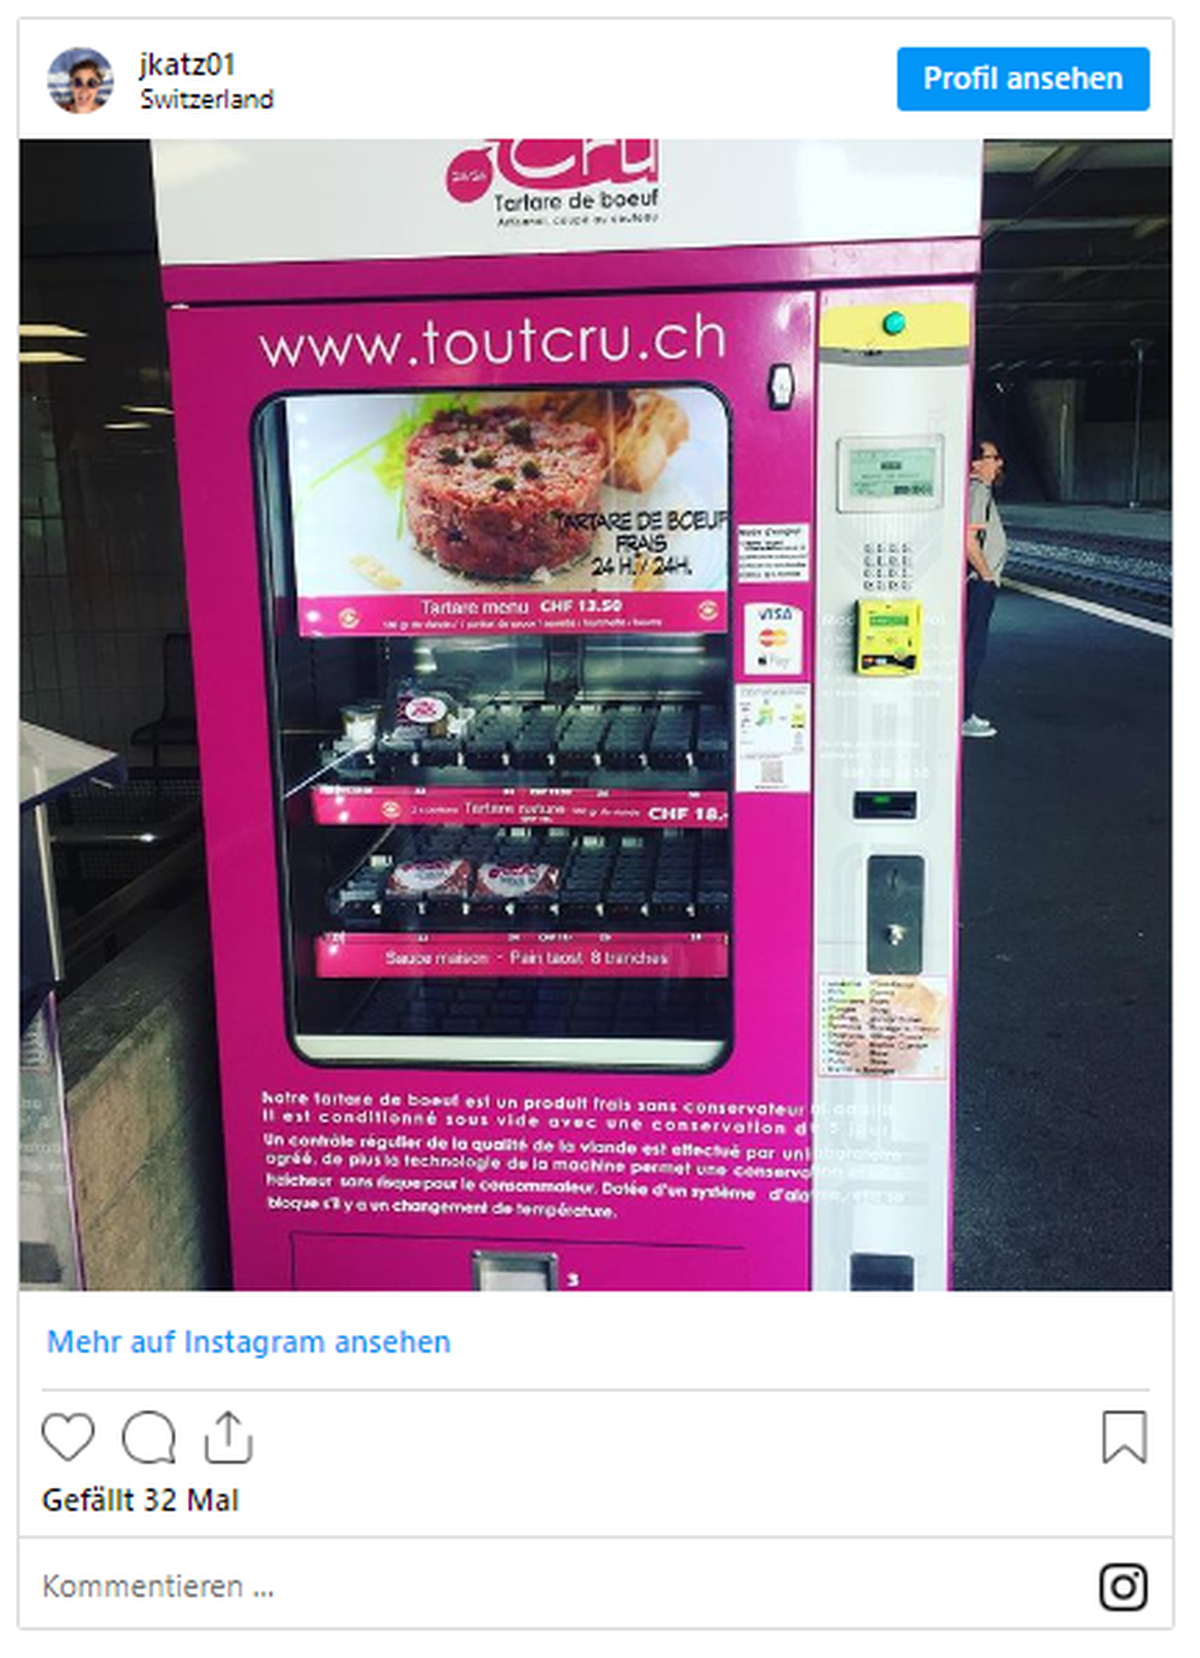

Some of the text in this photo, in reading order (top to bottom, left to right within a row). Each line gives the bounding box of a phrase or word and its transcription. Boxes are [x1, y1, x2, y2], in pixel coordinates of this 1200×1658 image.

[494, 188, 659, 212] Tartare de boeuf
[259, 312, 726, 368] www.toutcru.ch
[557, 511, 632, 531] TARTARE
[637, 511, 662, 530] DE
[616, 535, 667, 552] FRAIS
[592, 557, 615, 575] 24
[421, 599, 479, 615] Tartare
[483, 601, 529, 614] menu
[540, 599, 573, 612] CHF
[758, 608, 793, 620] VISA
[648, 807, 689, 820] CHF
[314, 1092, 373, 1106] tartare
[379, 1093, 402, 1106] de
[465, 1095, 490, 1109] est
[496, 1098, 518, 1109] un
[524, 1096, 589, 1112] produit
[593, 1097, 632, 1112] frais
[637, 1100, 678, 1113] sans
[683, 1101, 805, 1117] conservateur
[282, 1109, 311, 1123] est
[319, 1110, 438, 1126] conditionné
[446, 1114, 489, 1127] sous
[496, 1114, 540, 1129] vide
[549, 1117, 598, 1130] avec
[606, 1118, 643, 1131] une
[651, 1119, 786, 1135] conservation
[263, 1133, 284, 1147] Un
[289, 1133, 355, 1148] contrôle
[360, 1134, 422, 1151] régulier
[426, 1136, 449, 1149] de
[452, 1137, 468, 1150] la
[471, 1138, 528, 1154] qualité
[533, 1140, 554, 1152] de
[559, 1140, 575, 1153] la
[579, 1141, 637, 1155] viande
[641, 1143, 667, 1156] est
[672, 1143, 740, 1159] effectué
[746, 1147, 775, 1162] par
[321, 1151, 343, 1165] de
[349, 1153, 381, 1169] plus
[384, 1154, 399, 1168] la
[404, 1154, 501, 1173] technologie
[507, 1157, 528, 1170] de
[532, 1158, 548, 1171] la
[552, 1157, 626, 1173] machine
[630, 1161, 691, 1176] permet
[696, 1165, 727, 1177] une
[340, 1176, 373, 1188] sans
[423, 1178, 458, 1192] pour
[461, 1178, 475, 1191] le
[602, 1181, 649, 1196] Dotée
[652, 1183, 687, 1197] d'un
[691, 1185, 756, 1200] système
[268, 1196, 319, 1212] bloque
[344, 1200, 353, 1212] y
[356, 1201, 367, 1211] a
[370, 1201, 389, 1212] un
[392, 1199, 488, 1216] changement
[492, 1202, 513, 1215] de
[516, 1202, 618, 1219] température.
